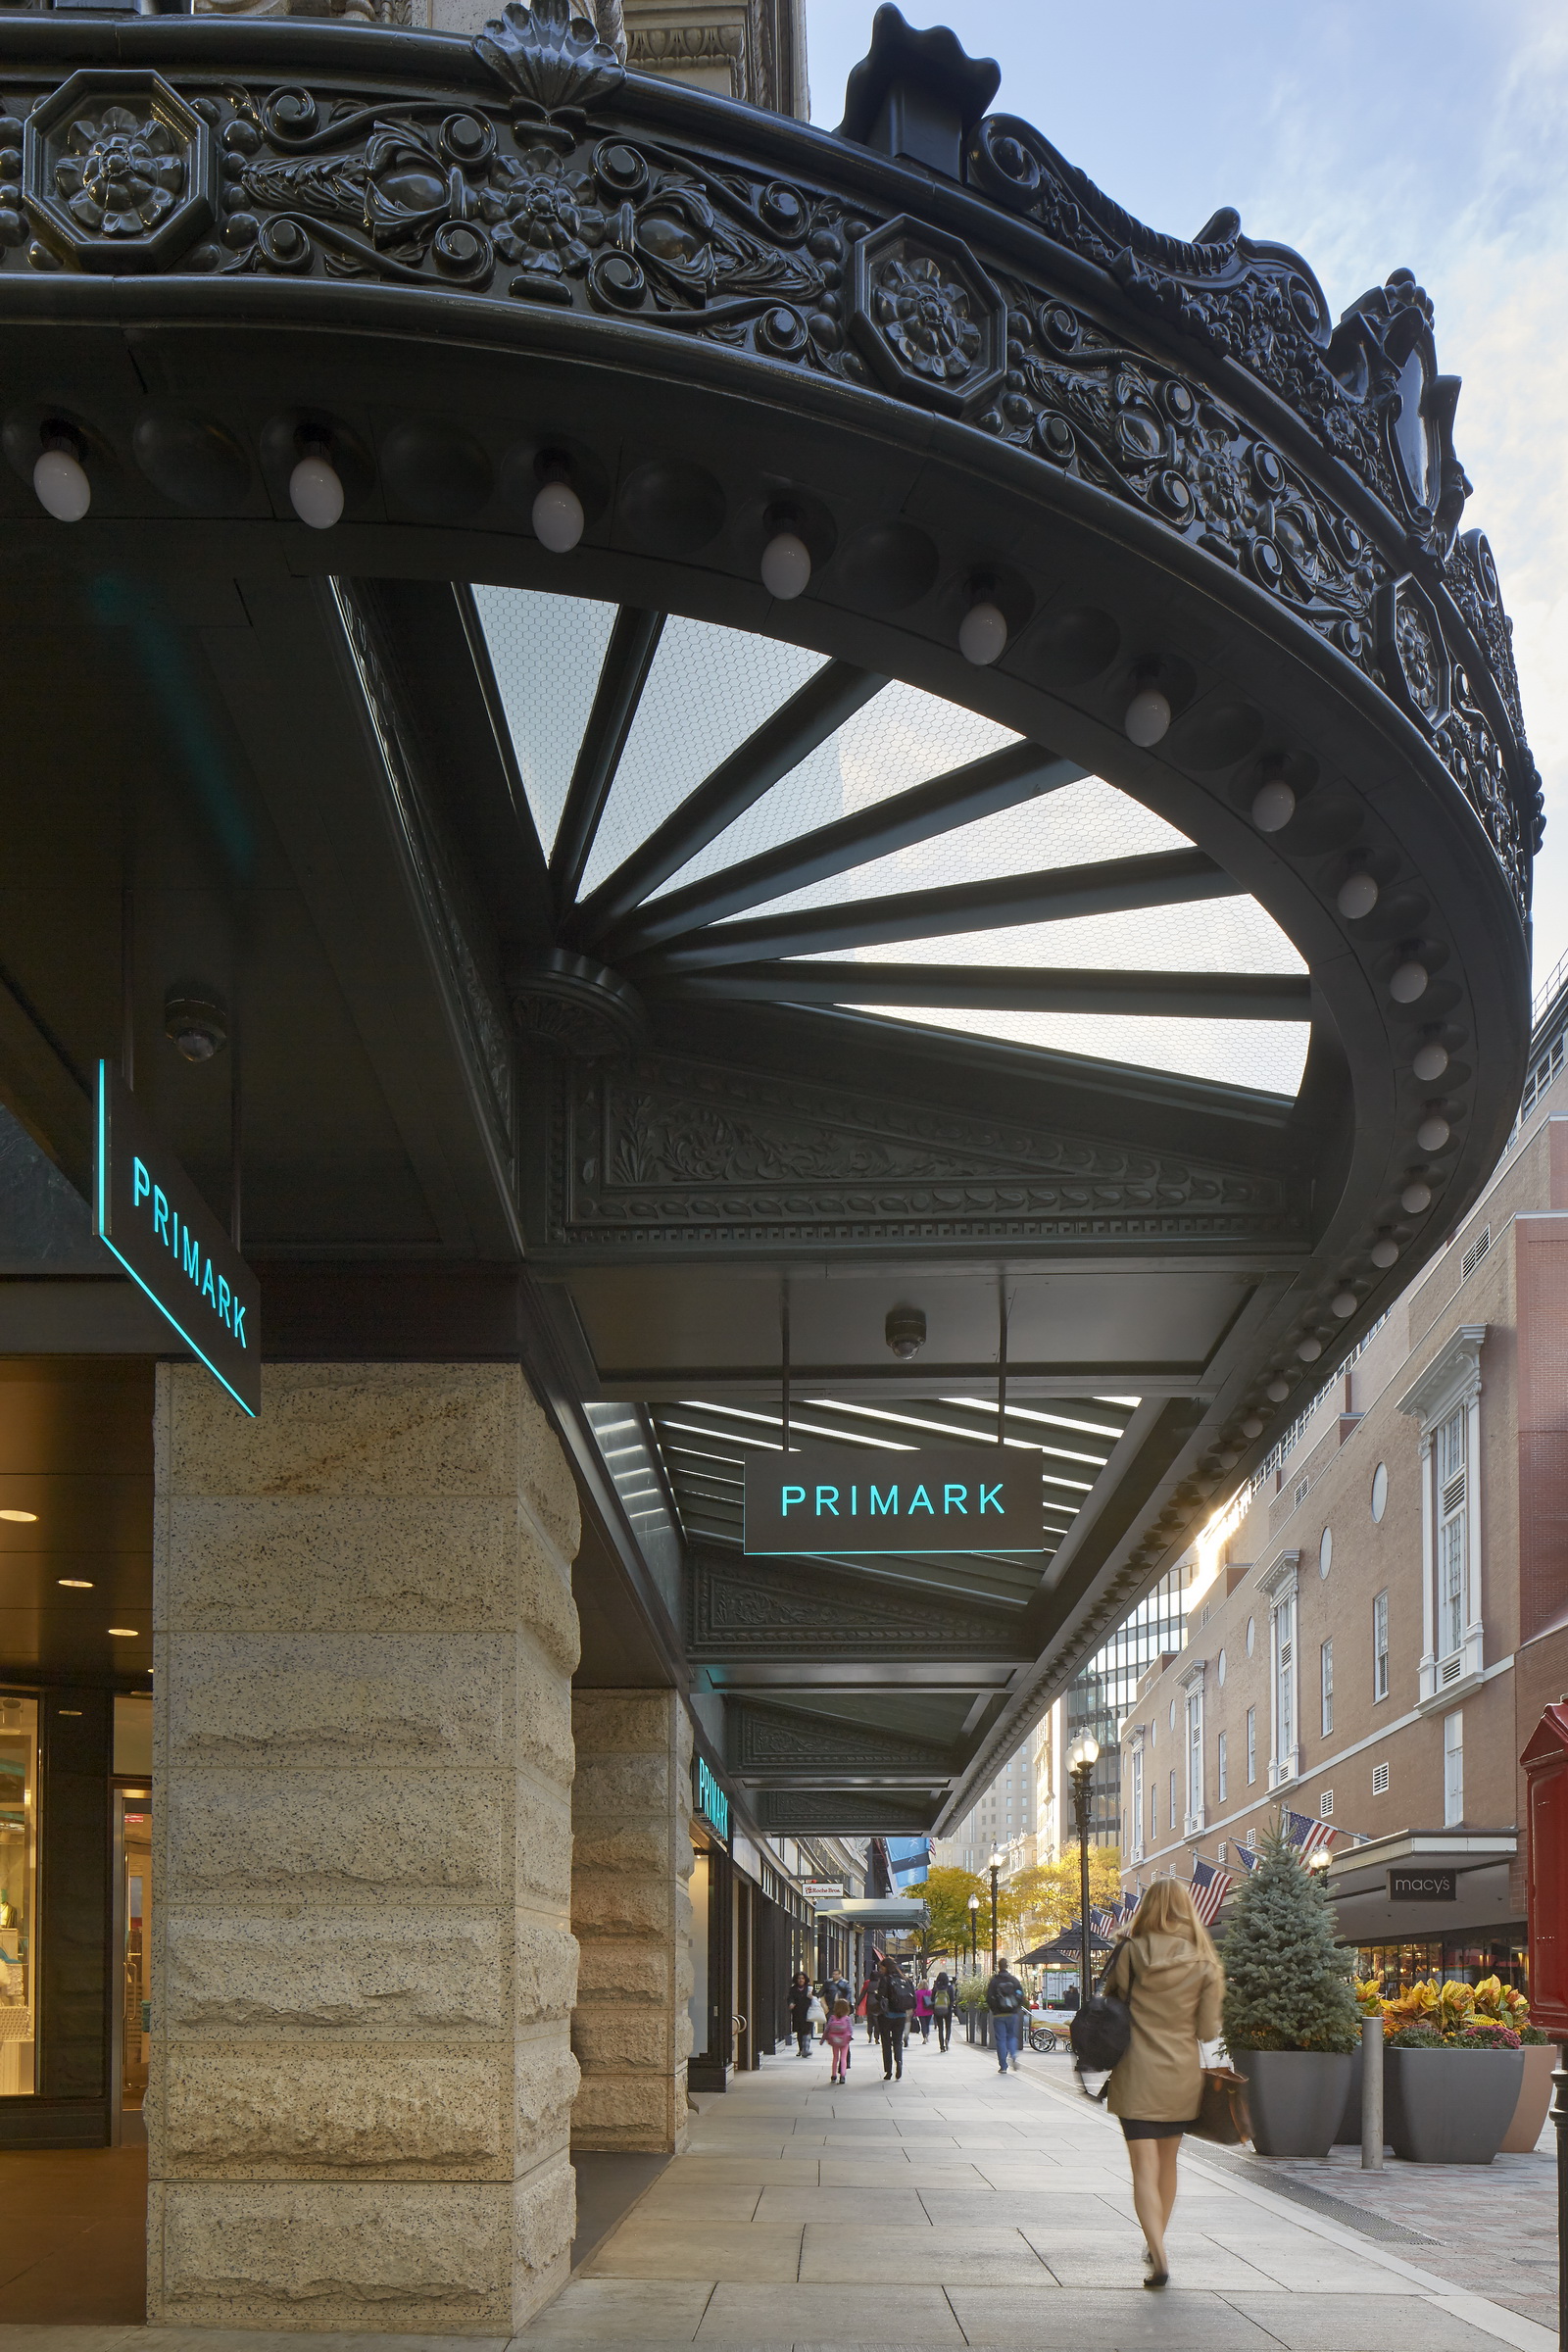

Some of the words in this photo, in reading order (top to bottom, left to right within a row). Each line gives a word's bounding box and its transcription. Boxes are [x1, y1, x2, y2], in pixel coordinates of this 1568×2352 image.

[133, 1156, 247, 1348] PRIMARK
[781, 1483, 1005, 1516] PRIMARK
[699, 1756, 729, 1841] PRIMARK
[1396, 1876, 1450, 1893] macy's
